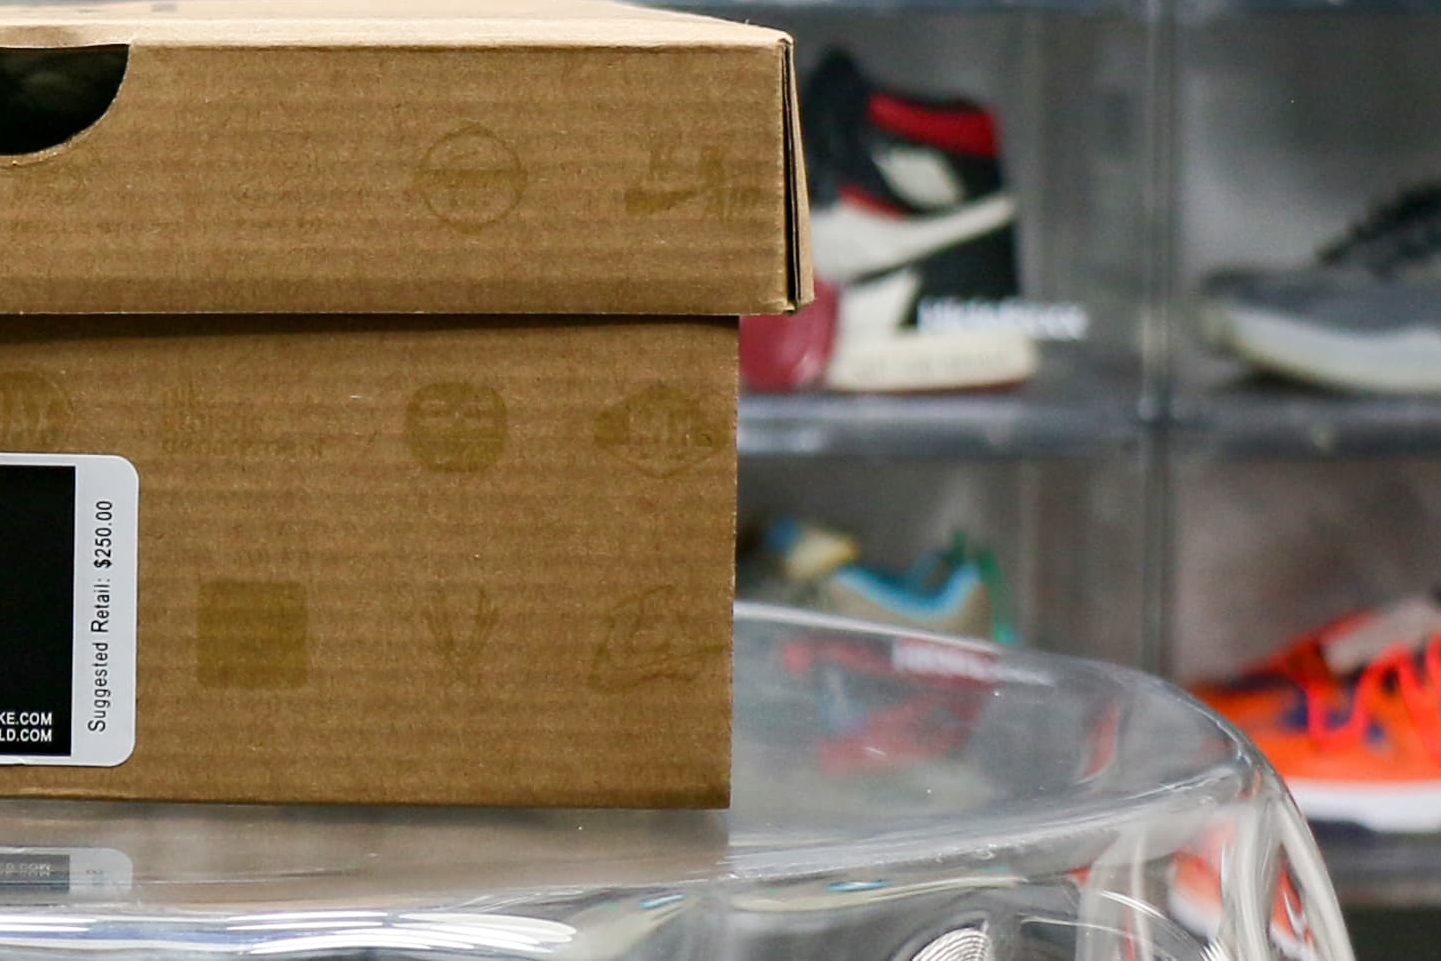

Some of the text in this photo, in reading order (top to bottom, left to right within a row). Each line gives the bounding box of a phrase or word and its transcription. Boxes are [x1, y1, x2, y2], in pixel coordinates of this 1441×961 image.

[87, 499, 114, 733] Suggested Retail: $250.00
